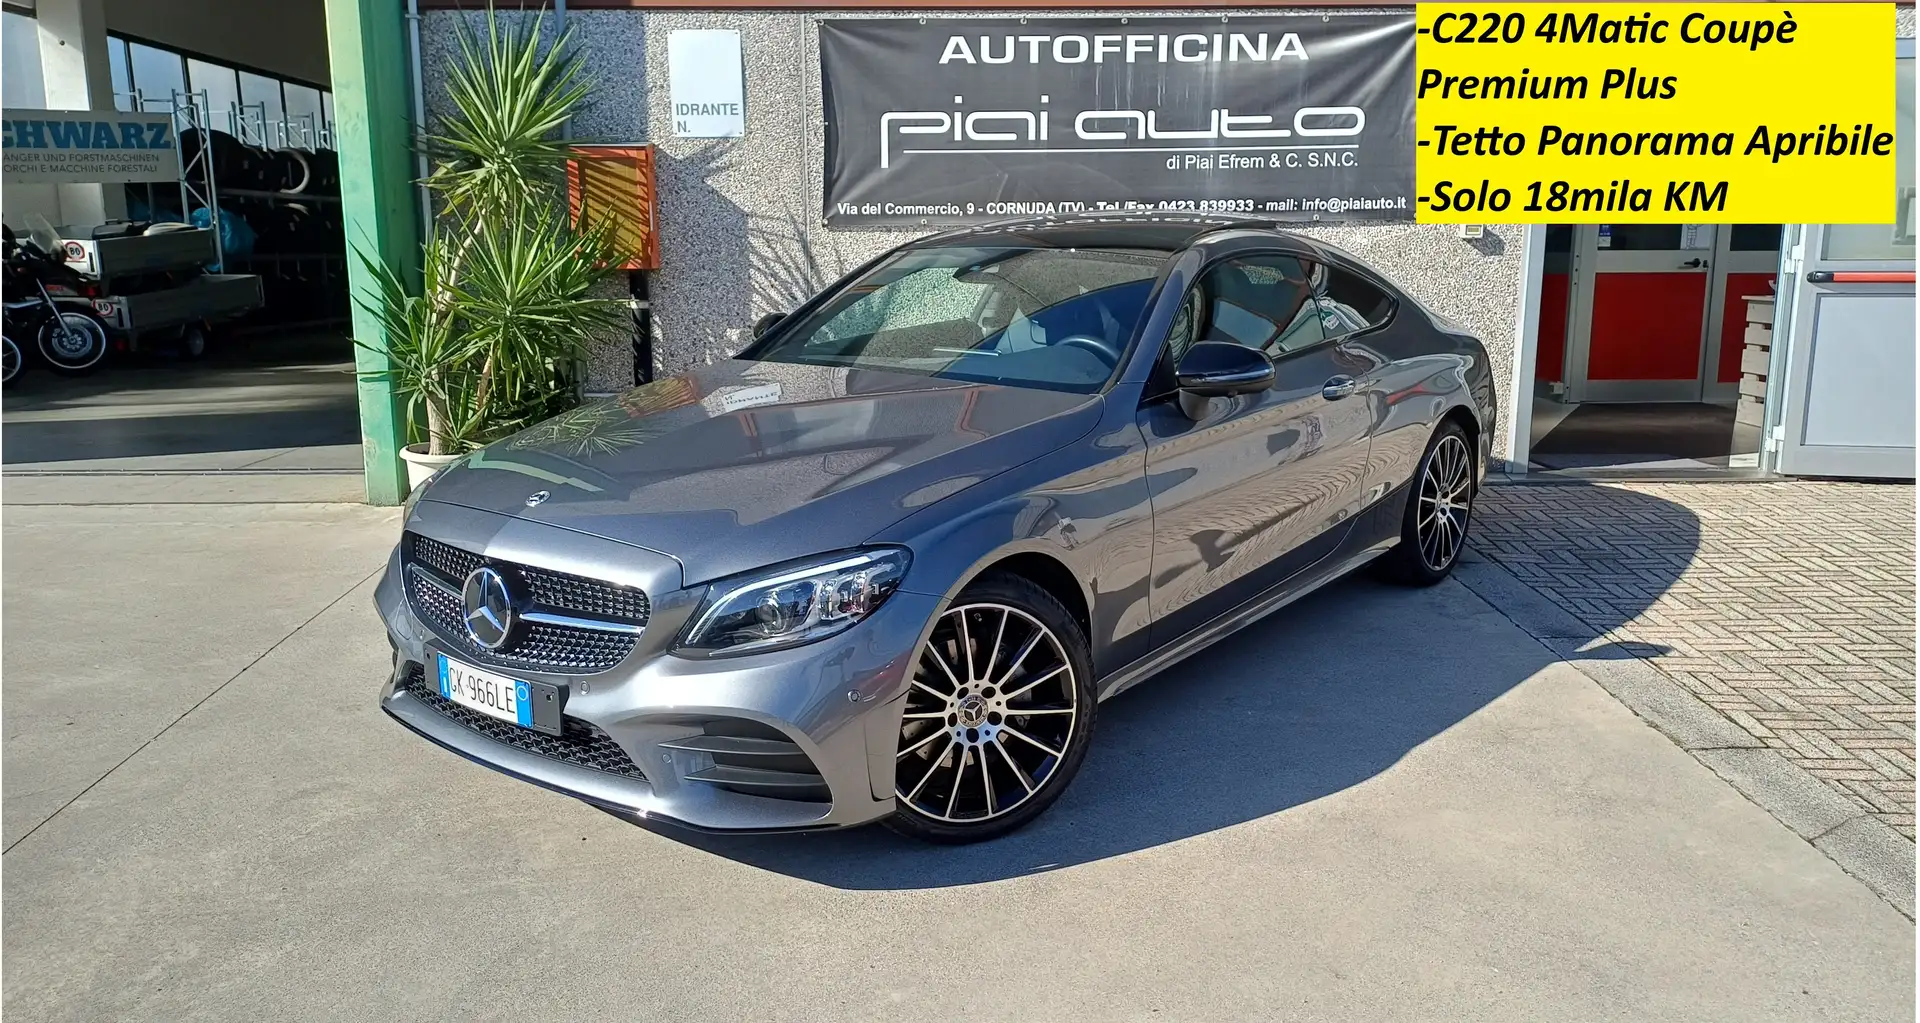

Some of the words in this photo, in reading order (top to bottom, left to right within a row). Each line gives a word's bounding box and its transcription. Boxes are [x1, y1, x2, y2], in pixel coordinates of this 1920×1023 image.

[939, 33, 1309, 65] AUTOFFICINA
[675, 103, 739, 116] IDRANTE
[677, 120, 691, 133] N.
[881, 95, 1048, 168] piai
[1075, 106, 1366, 140] auto
[43, 153, 66, 162] UND
[69, 153, 160, 162] FORSTMASCHINEN
[1166, 155, 1180, 170] di
[1185, 153, 1215, 170] Piai
[1218, 153, 1265, 169] Efrem
[1269, 153, 1281, 169] &
[1286, 153, 1303, 168] C.
[1307, 152, 1359, 168] S.N.C.
[41, 164, 47, 173] E
[50, 164, 105, 173] MACCHINE
[107, 164, 158, 173] FORESTALI
[837, 202, 858, 215] Via
[861, 202, 882, 215] del
[885, 202, 963, 217] Commercio,
[966, 202, 975, 215] 9
[986, 202, 1056, 215] CORNUDA
[1058, 201, 1086, 213] (TV)
[1265, 199, 1298, 212] mail:
[1301, 196, 1407, 213] info@piaiauto.it
